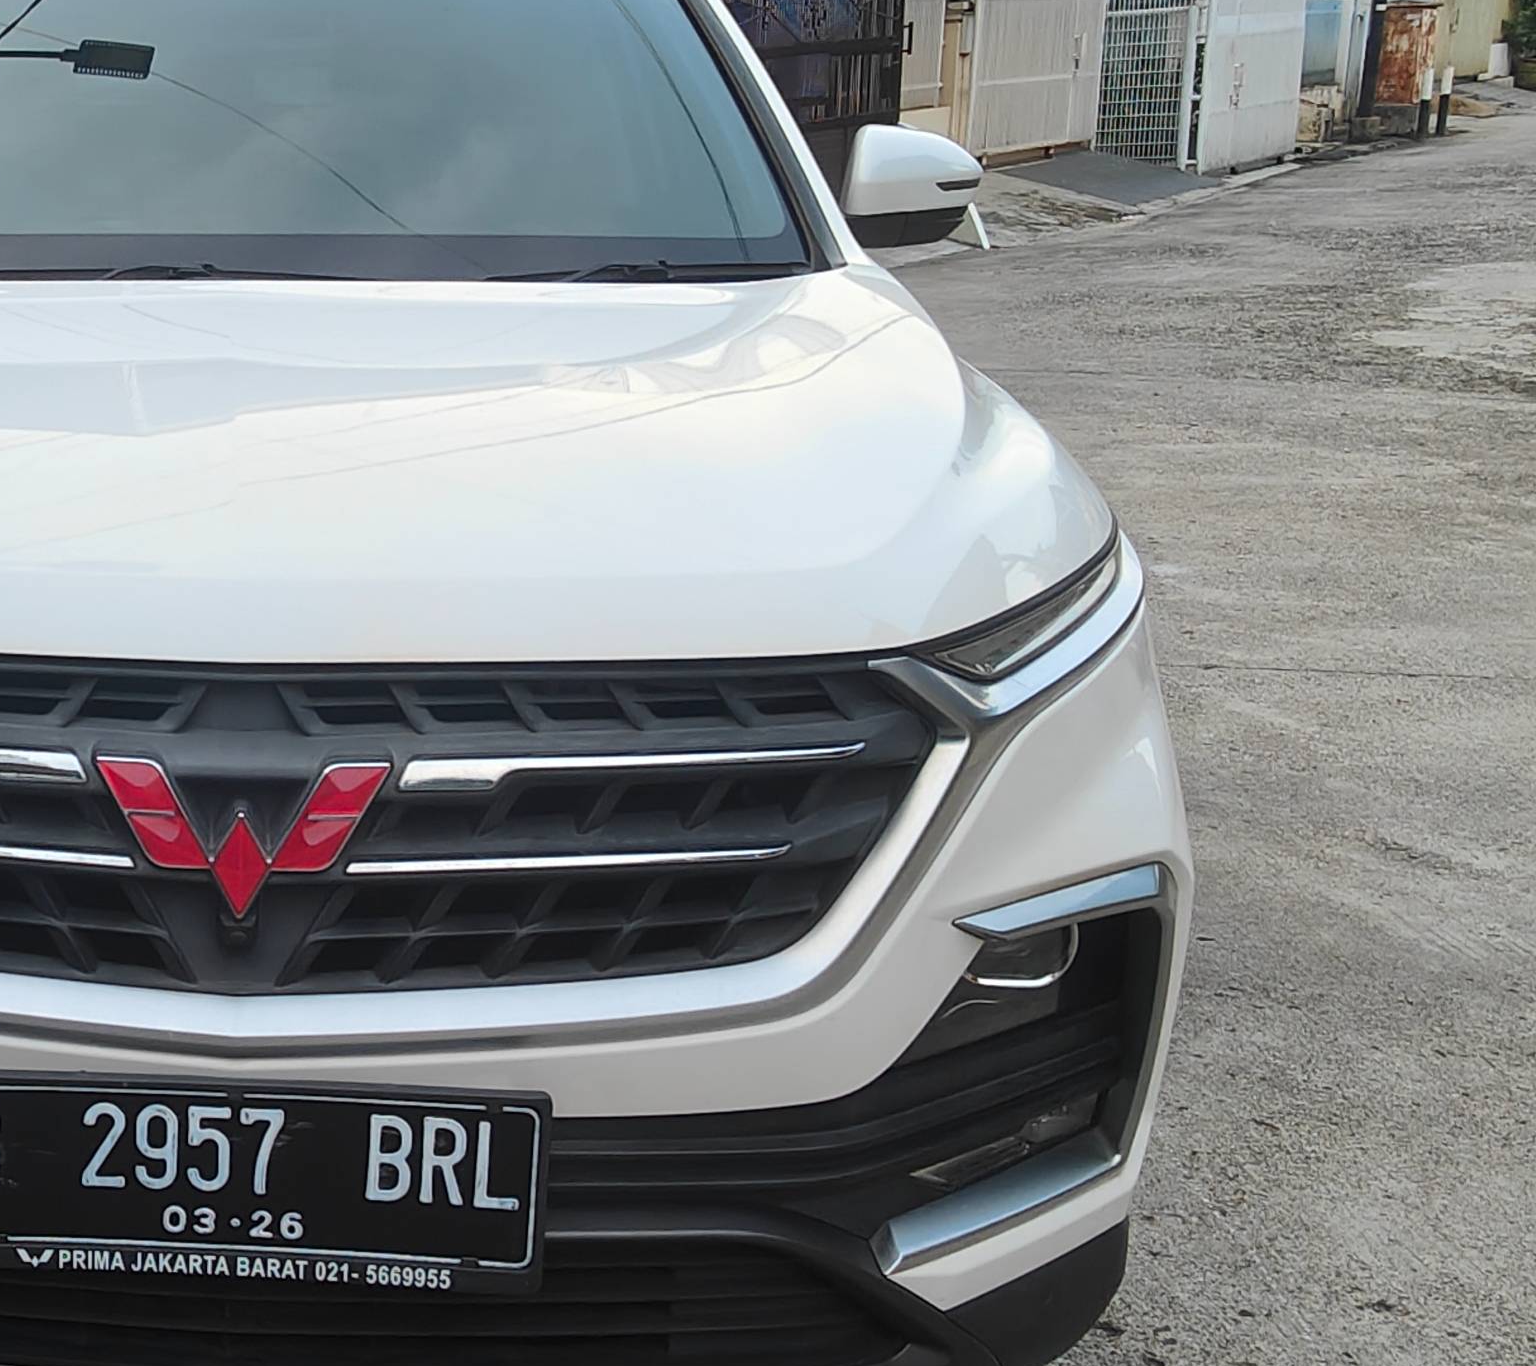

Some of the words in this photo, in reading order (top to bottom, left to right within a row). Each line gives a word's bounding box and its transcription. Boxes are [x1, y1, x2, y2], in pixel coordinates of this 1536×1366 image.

[81, 1101, 285, 1196] 2957
[364, 1113, 520, 1211] BRL
[57, 1249, 126, 1272] PRIMA
[131, 1251, 230, 1277] JAKARTA
[235, 1256, 309, 1280] BARAT
[365, 1264, 452, 1290] 5669955
